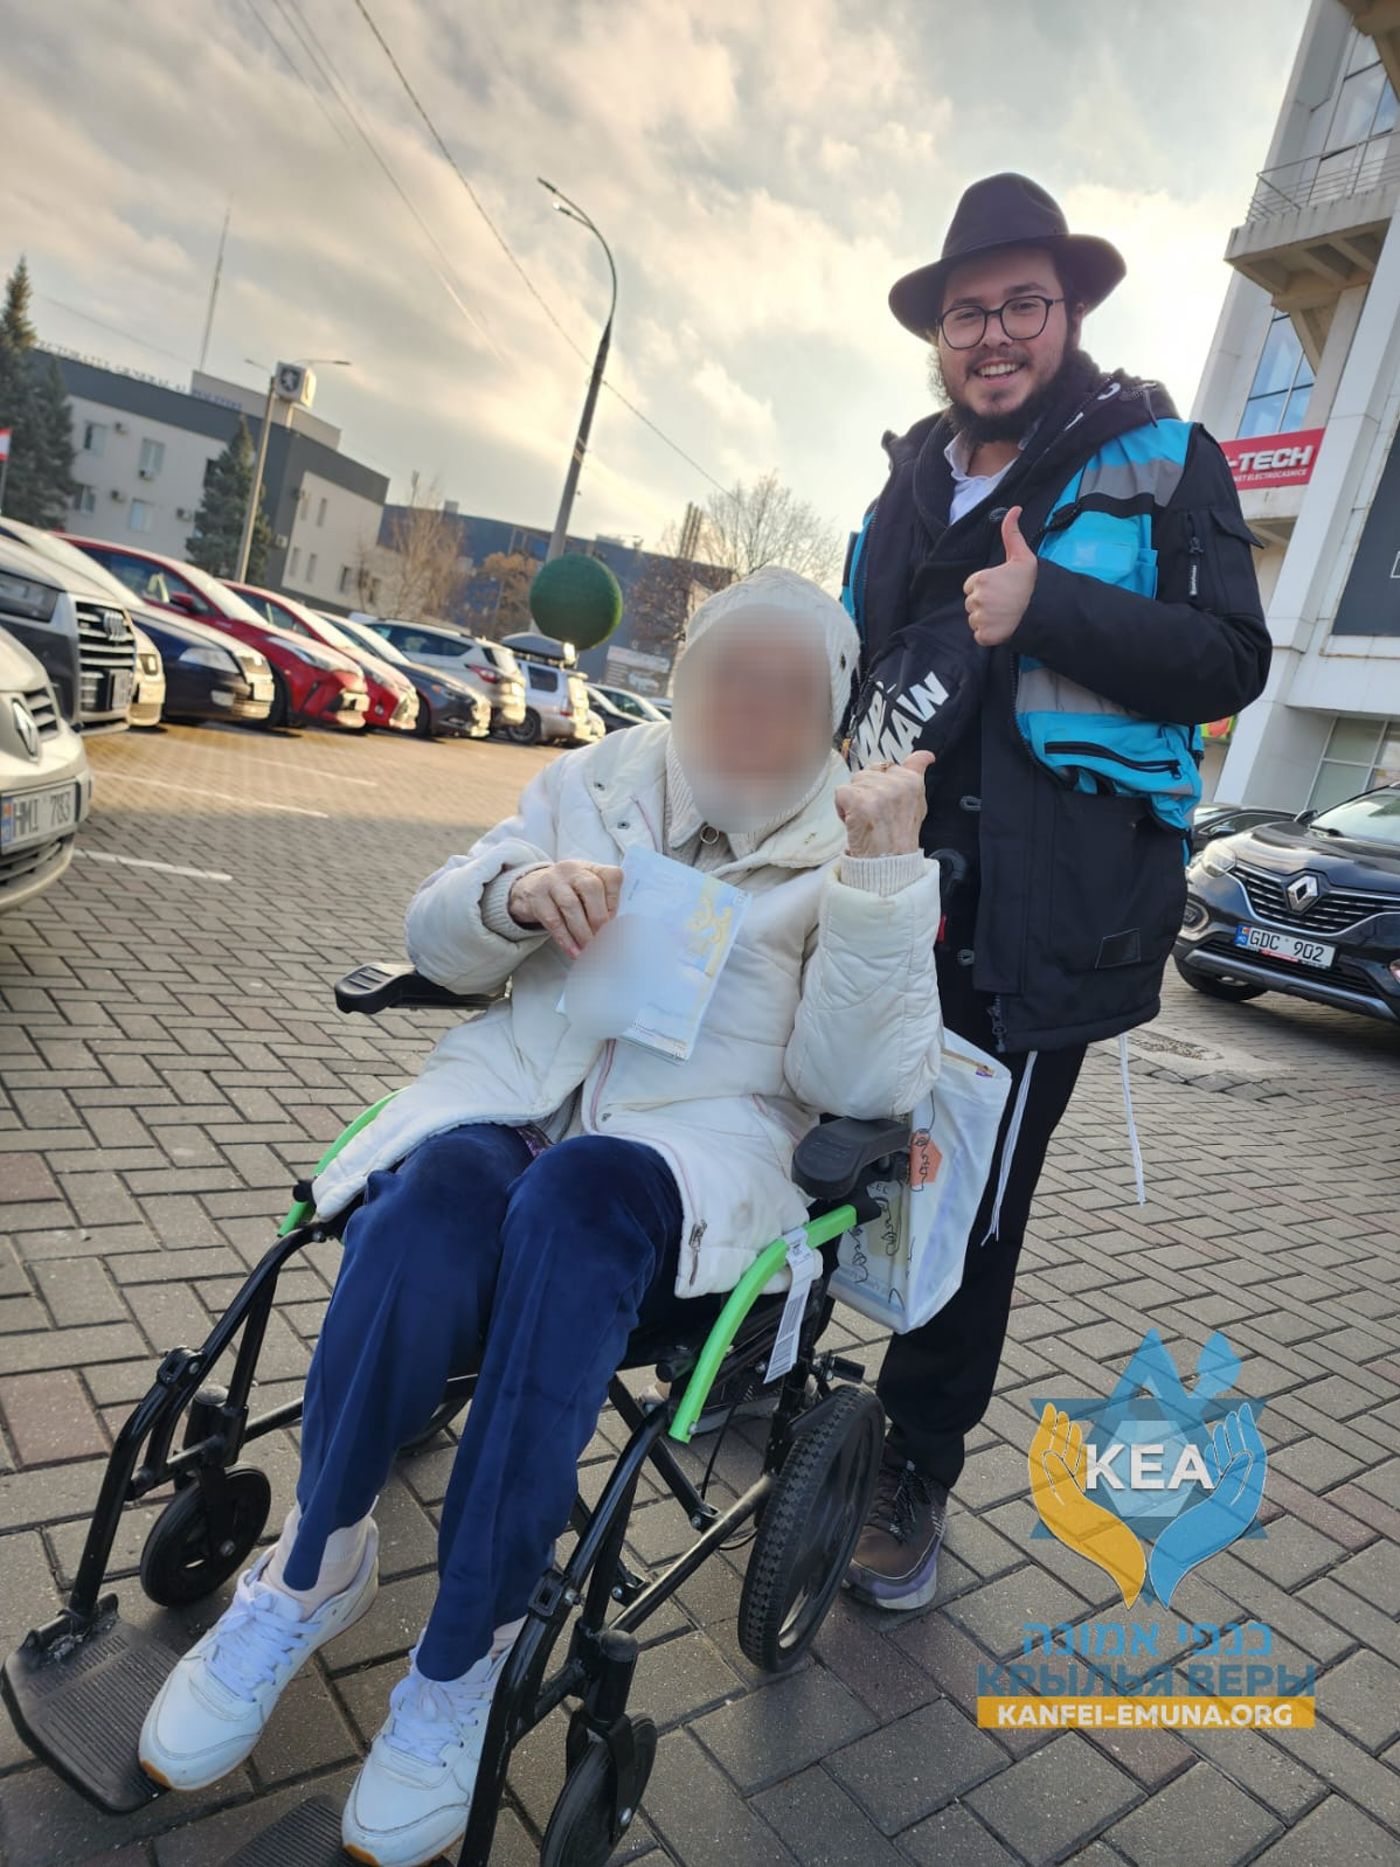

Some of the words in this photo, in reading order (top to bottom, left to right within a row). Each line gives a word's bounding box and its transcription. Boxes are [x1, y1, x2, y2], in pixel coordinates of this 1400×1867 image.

[1226, 445, 1313, 473] -TECH
[1249, 930, 1280, 951] GDC
[1294, 941, 1325, 963] 902
